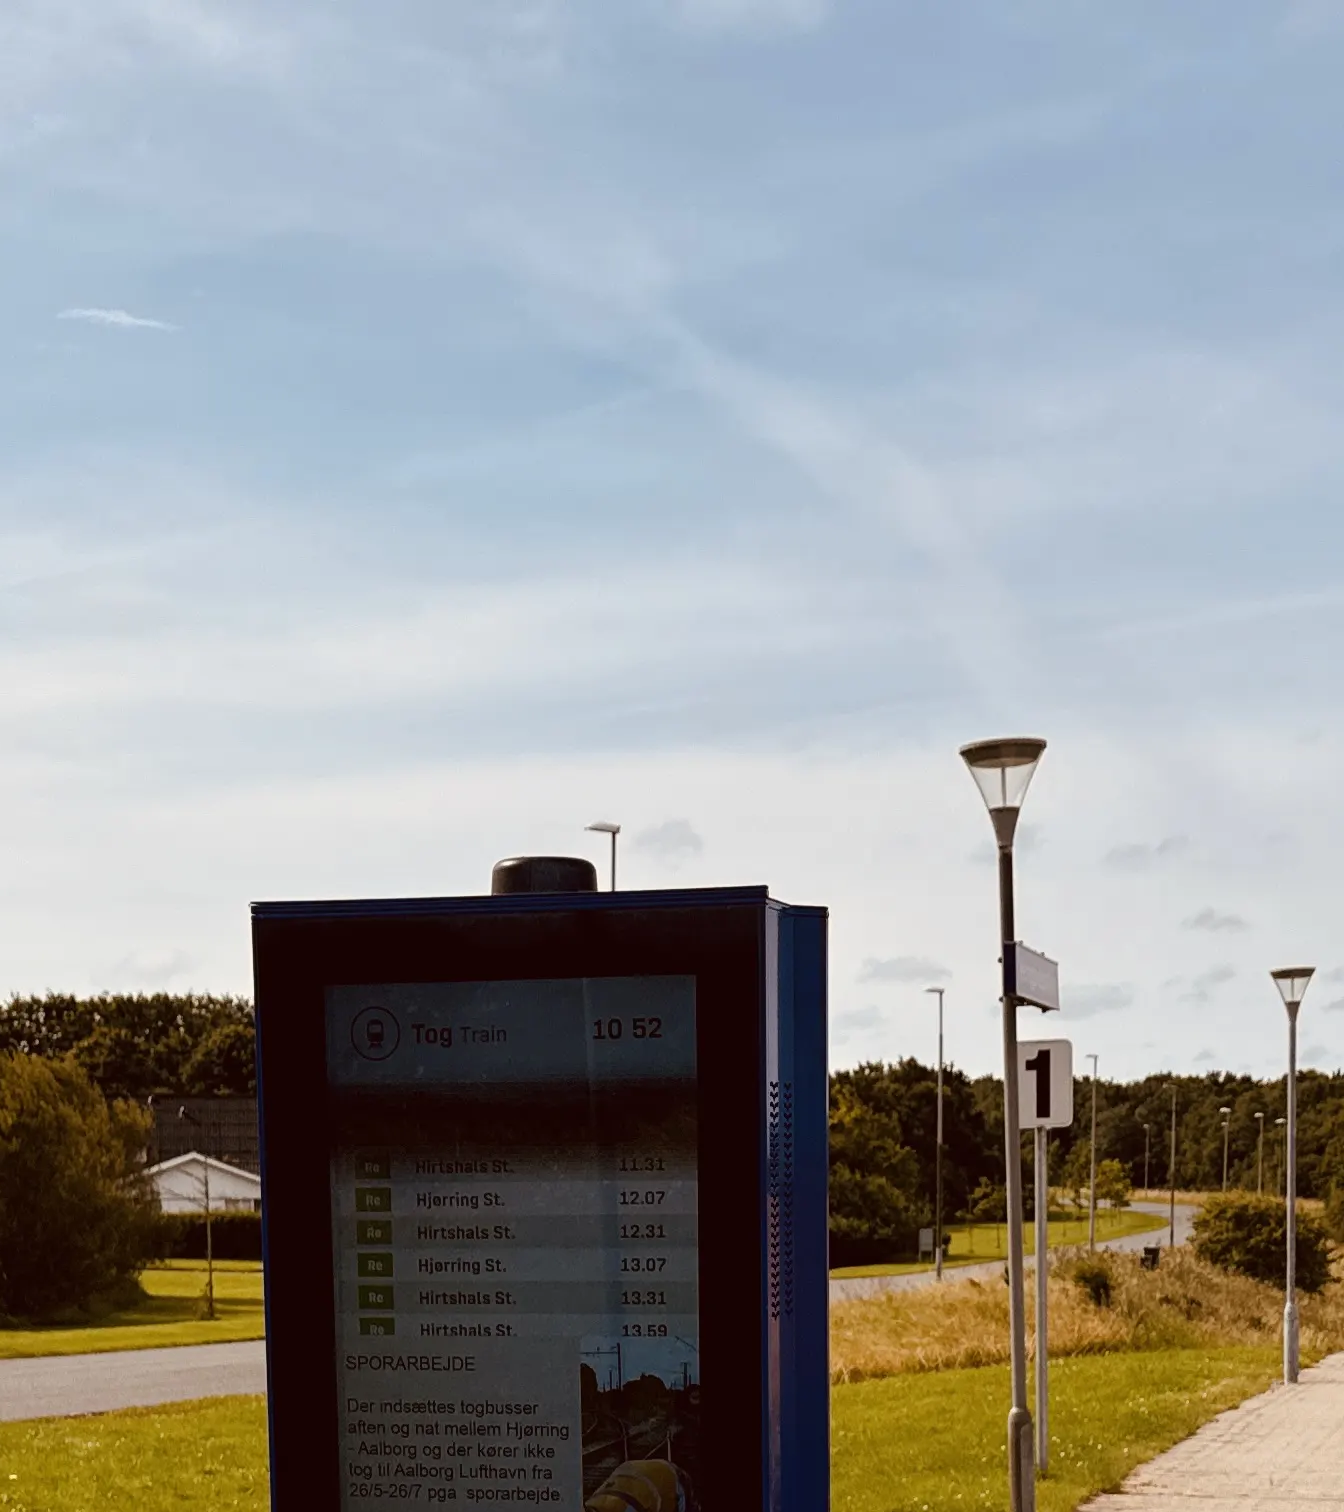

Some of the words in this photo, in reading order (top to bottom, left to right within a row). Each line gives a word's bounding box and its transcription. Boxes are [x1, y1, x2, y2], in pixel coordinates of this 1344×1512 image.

[412, 1024, 452, 1048] Tog
[461, 1027, 507, 1042] Train
[1025, 1049, 1050, 1118] 1
[416, 1160, 488, 1173] Hirtshals
[492, 1161, 514, 1173] St.
[620, 1159, 665, 1171] 11.31
[366, 1194, 381, 1206] Re
[417, 1193, 479, 1209] Hjørring
[484, 1194, 505, 1206] St.
[620, 1191, 666, 1205] 12.07
[367, 1227, 381, 1238] Re
[418, 1226, 489, 1239] Hirtshals
[494, 1226, 516, 1239] St.
[620, 1225, 666, 1238] 12.31
[367, 1260, 383, 1270] Re
[419, 1259, 481, 1274] Hjørring
[486, 1259, 506, 1272] St.
[621, 1258, 666, 1271] 13.07
[368, 1292, 384, 1303] Re
[419, 1292, 491, 1305] Hirtshals
[495, 1292, 517, 1305] St.
[622, 1291, 666, 1305] 13.31
[370, 1324, 384, 1335] Re
[421, 1324, 492, 1337] Hirtshals
[497, 1325, 517, 1336] St.
[622, 1324, 667, 1337] 13.59
[346, 1356, 476, 1371] SPORARBEJDE
[348, 1399, 375, 1413] Der
[380, 1401, 455, 1414] indsættes
[460, 1401, 539, 1417] togbusser
[348, 1422, 386, 1434] aften
[391, 1425, 409, 1437] og
[415, 1423, 439, 1435] nat
[445, 1423, 501, 1436] mellem
[507, 1424, 569, 1440] Hjørring
[358, 1443, 417, 1458] Aalborg
[423, 1448, 441, 1459] og
[447, 1444, 472, 1457] der
[478, 1444, 519, 1458] kører
[524, 1445, 555, 1458] ikke
[349, 1465, 372, 1477] tog
[378, 1464, 390, 1476] til
[395, 1465, 454, 1480] Aalborg
[460, 1465, 527, 1479] Lufthavn
[532, 1466, 552, 1479] fra
[350, 1484, 422, 1498] 26/5-26/7
